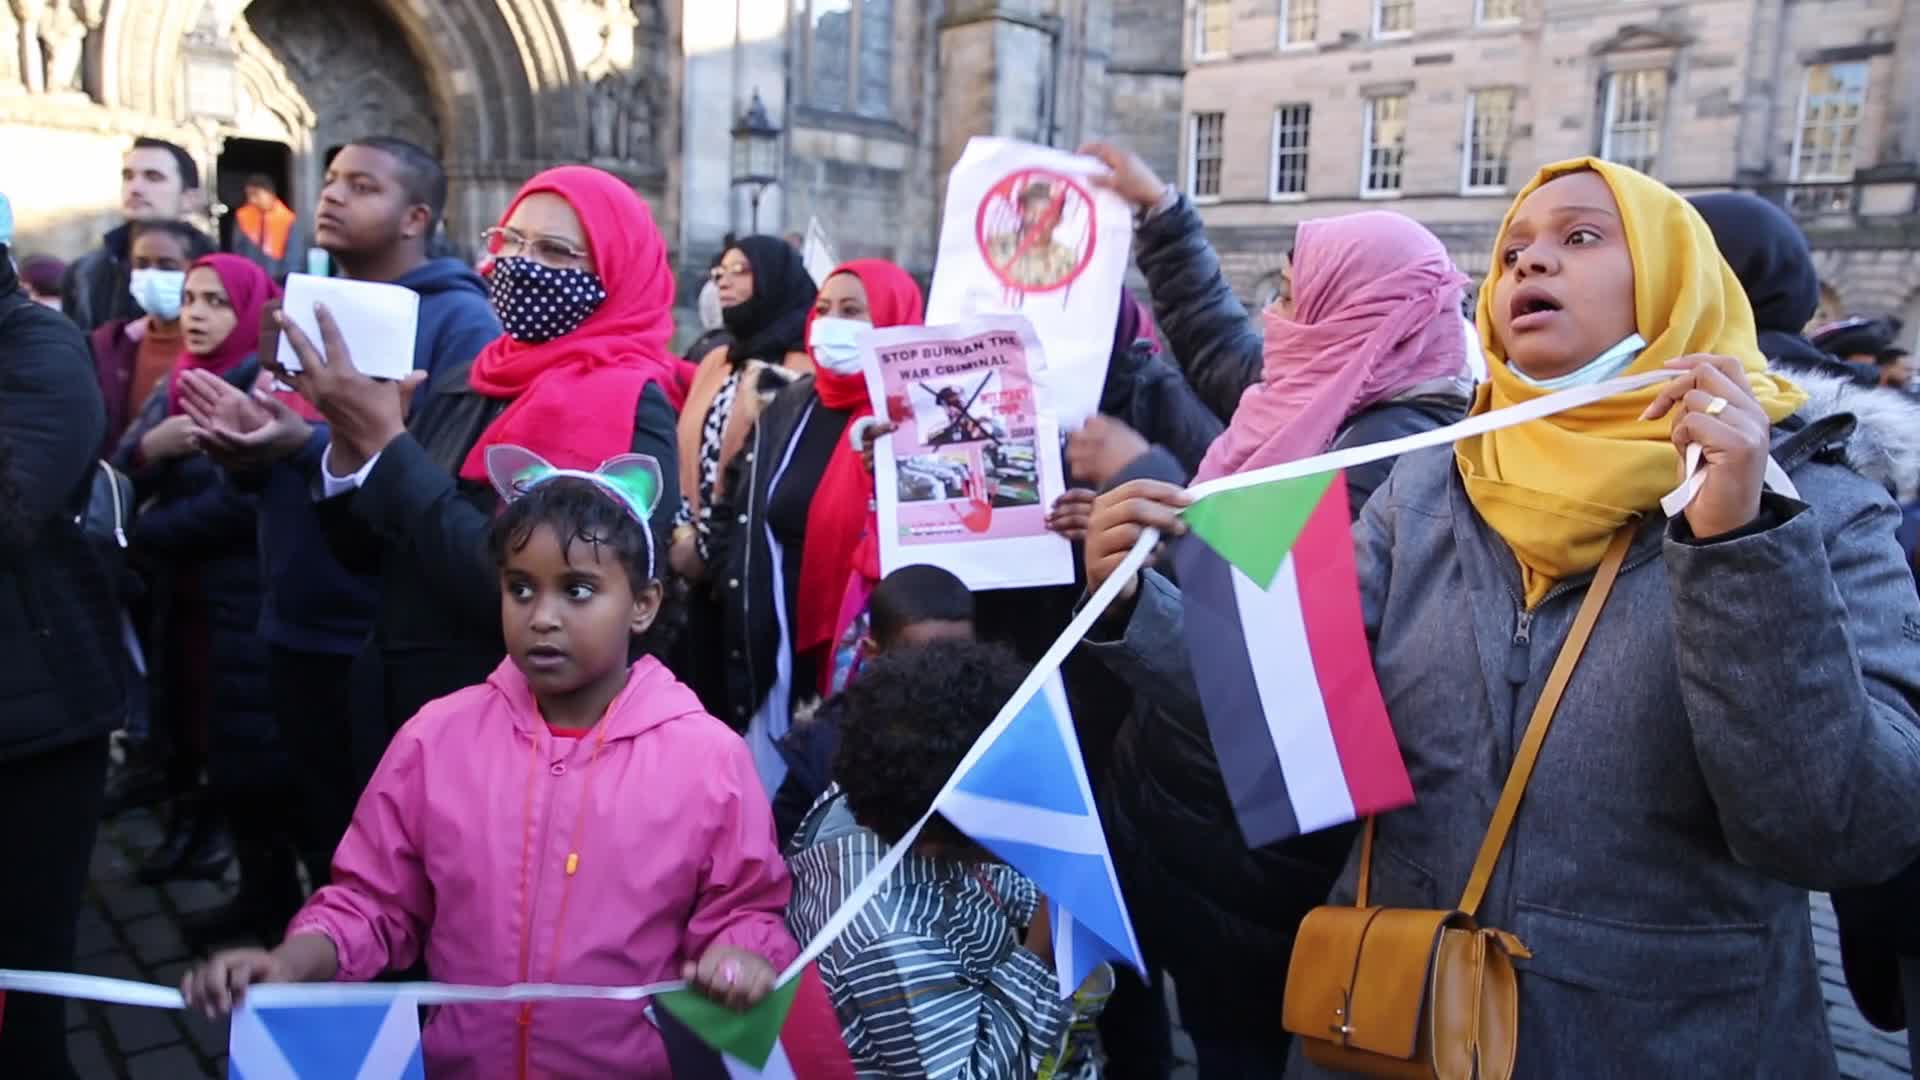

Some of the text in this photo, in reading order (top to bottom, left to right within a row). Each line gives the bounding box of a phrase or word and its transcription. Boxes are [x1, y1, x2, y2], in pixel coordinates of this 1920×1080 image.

[881, 336, 1016, 364] STOP BURHAN THE
[900, 354, 1008, 380] WAR CRIMINAL
